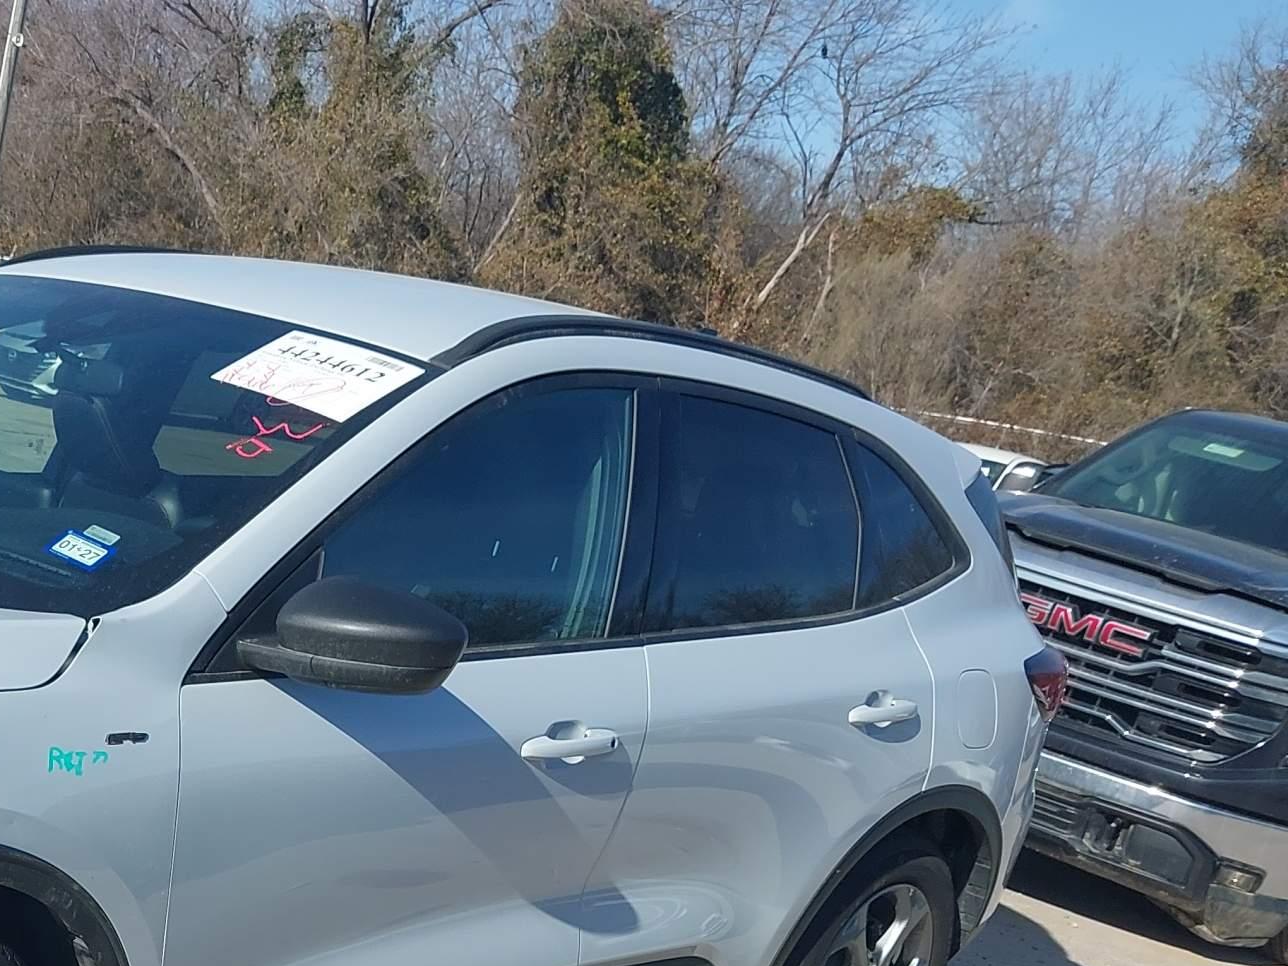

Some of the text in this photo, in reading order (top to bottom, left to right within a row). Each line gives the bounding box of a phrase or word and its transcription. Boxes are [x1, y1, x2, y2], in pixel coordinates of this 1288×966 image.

[277, 346, 386, 383] 44244612
[58, 540, 78, 552] 01
[1020, 592, 1151, 657] GMC
